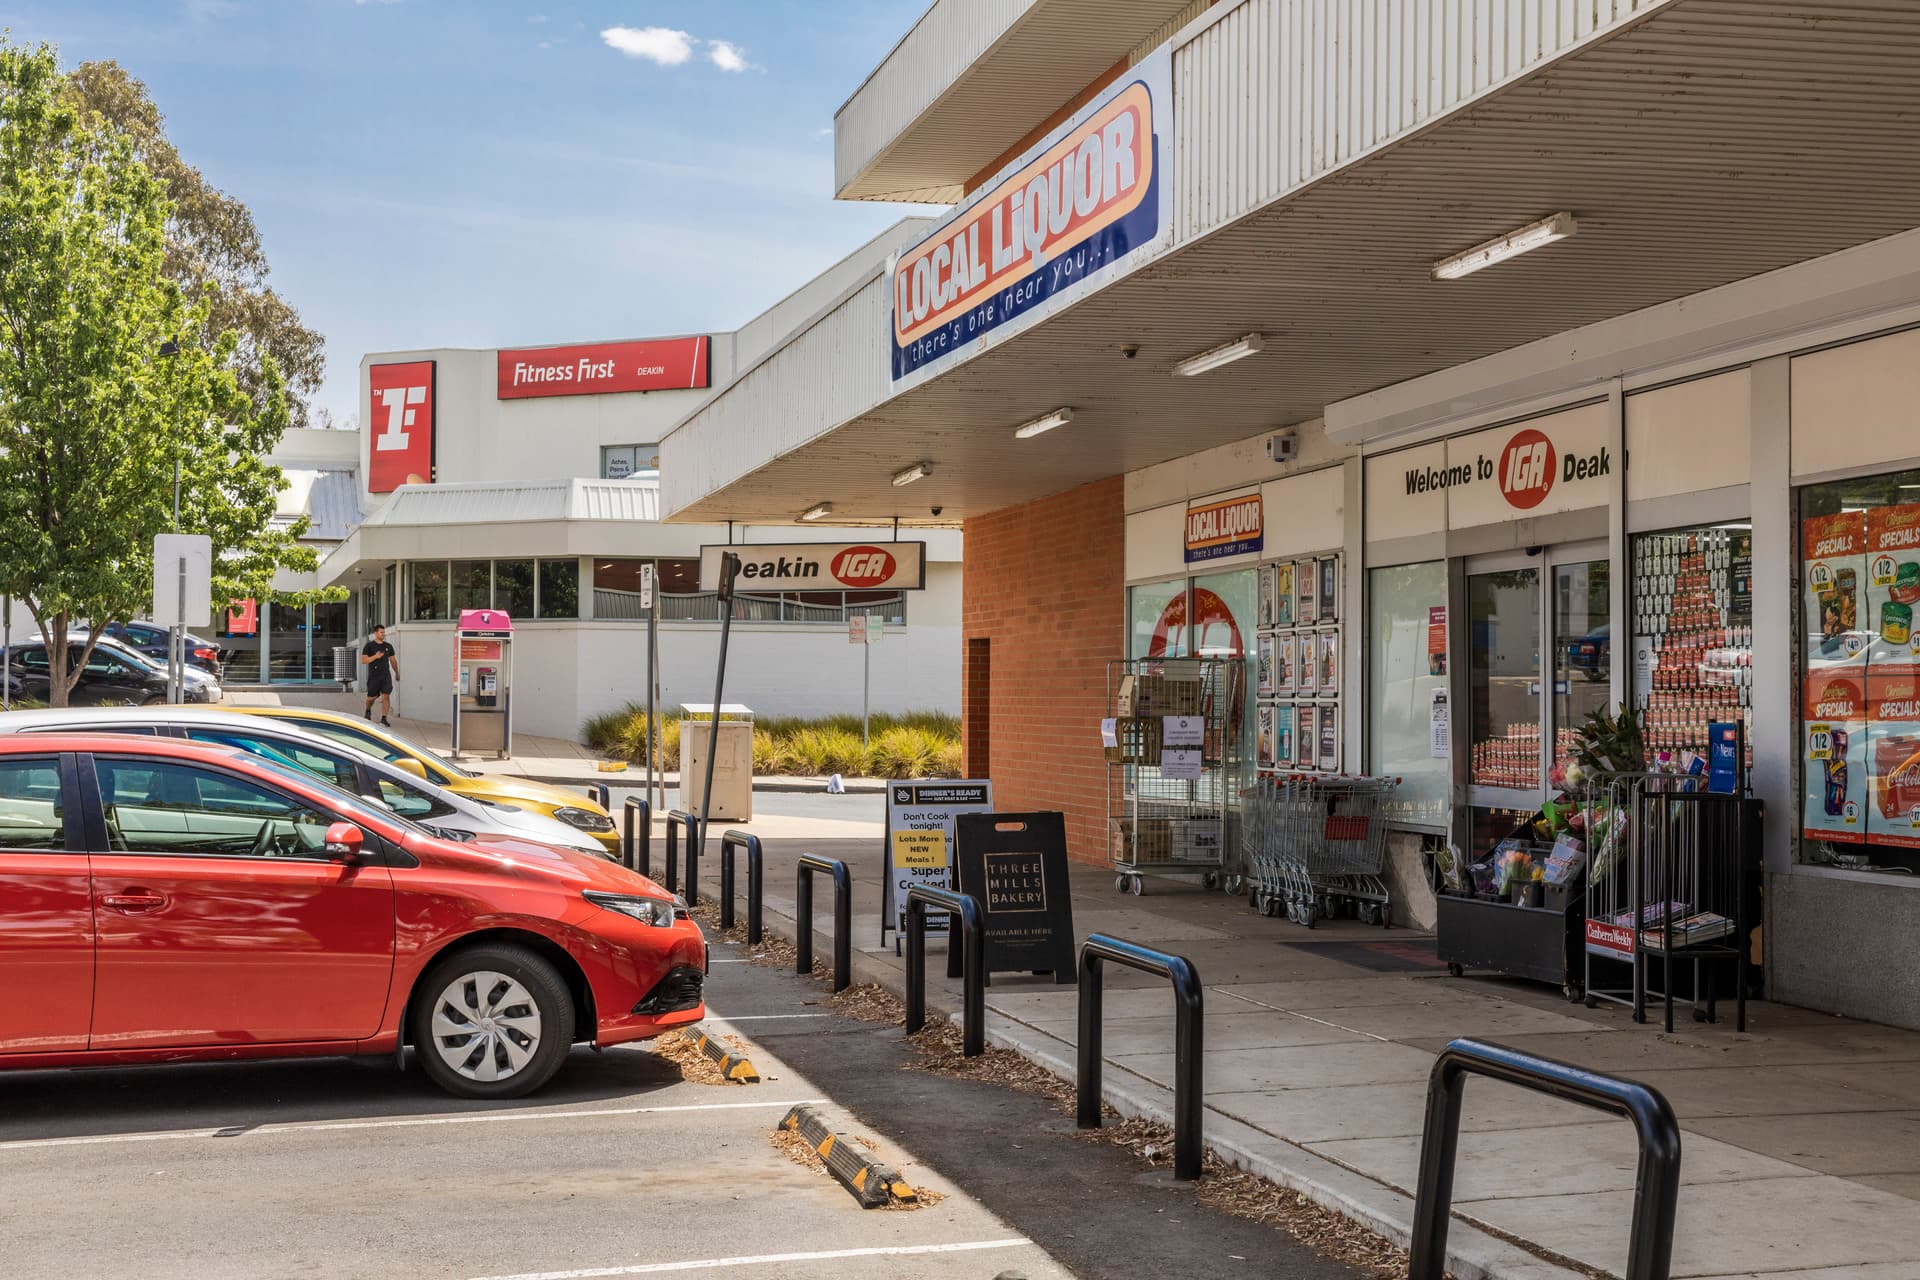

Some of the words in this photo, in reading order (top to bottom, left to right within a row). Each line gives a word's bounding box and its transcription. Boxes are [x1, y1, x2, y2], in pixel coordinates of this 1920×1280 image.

[899, 220, 986, 332] LOCAL
[912, 322, 960, 363] there's
[969, 303, 994, 332] one
[1005, 275, 1044, 313] near
[513, 362, 574, 386] Fitness
[577, 358, 615, 382] First
[637, 366, 664, 376] DEAKIN
[1405, 463, 1472, 495] Welcome
[1477, 454, 1493, 480] to
[1504, 441, 1548, 493] IGA
[1563, 447, 1629, 482] Deak
[1188, 510, 1219, 542] LOCAL
[1880, 528, 1920, 548] SPECIALS
[1193, 547, 1211, 559] there's
[1213, 547, 1222, 556] one
[1224, 544, 1236, 553] near
[1816, 535, 1853, 557] SPECIALS
[837, 553, 886, 578] IGA
[1879, 560, 1891, 575] 1/2
[1815, 568, 1827, 582] 1/2
[1816, 701, 1853, 718] SPECIALS
[1880, 701, 1920, 718] SPECIALS
[1815, 733, 1827, 749] 1/2
[957, 789, 982, 797] READY
[903, 812, 925, 821] Don't
[927, 812, 949, 821] Cook
[910, 822, 943, 831] tonight!
[911, 867, 945, 877] Super
[989, 863, 1039, 874] THREE
[990, 878, 1041, 888] MILLS
[992, 893, 1041, 904] BAKERY
[985, 928, 1028, 937] AVAILABLE
[1032, 927, 1053, 935] HERE
